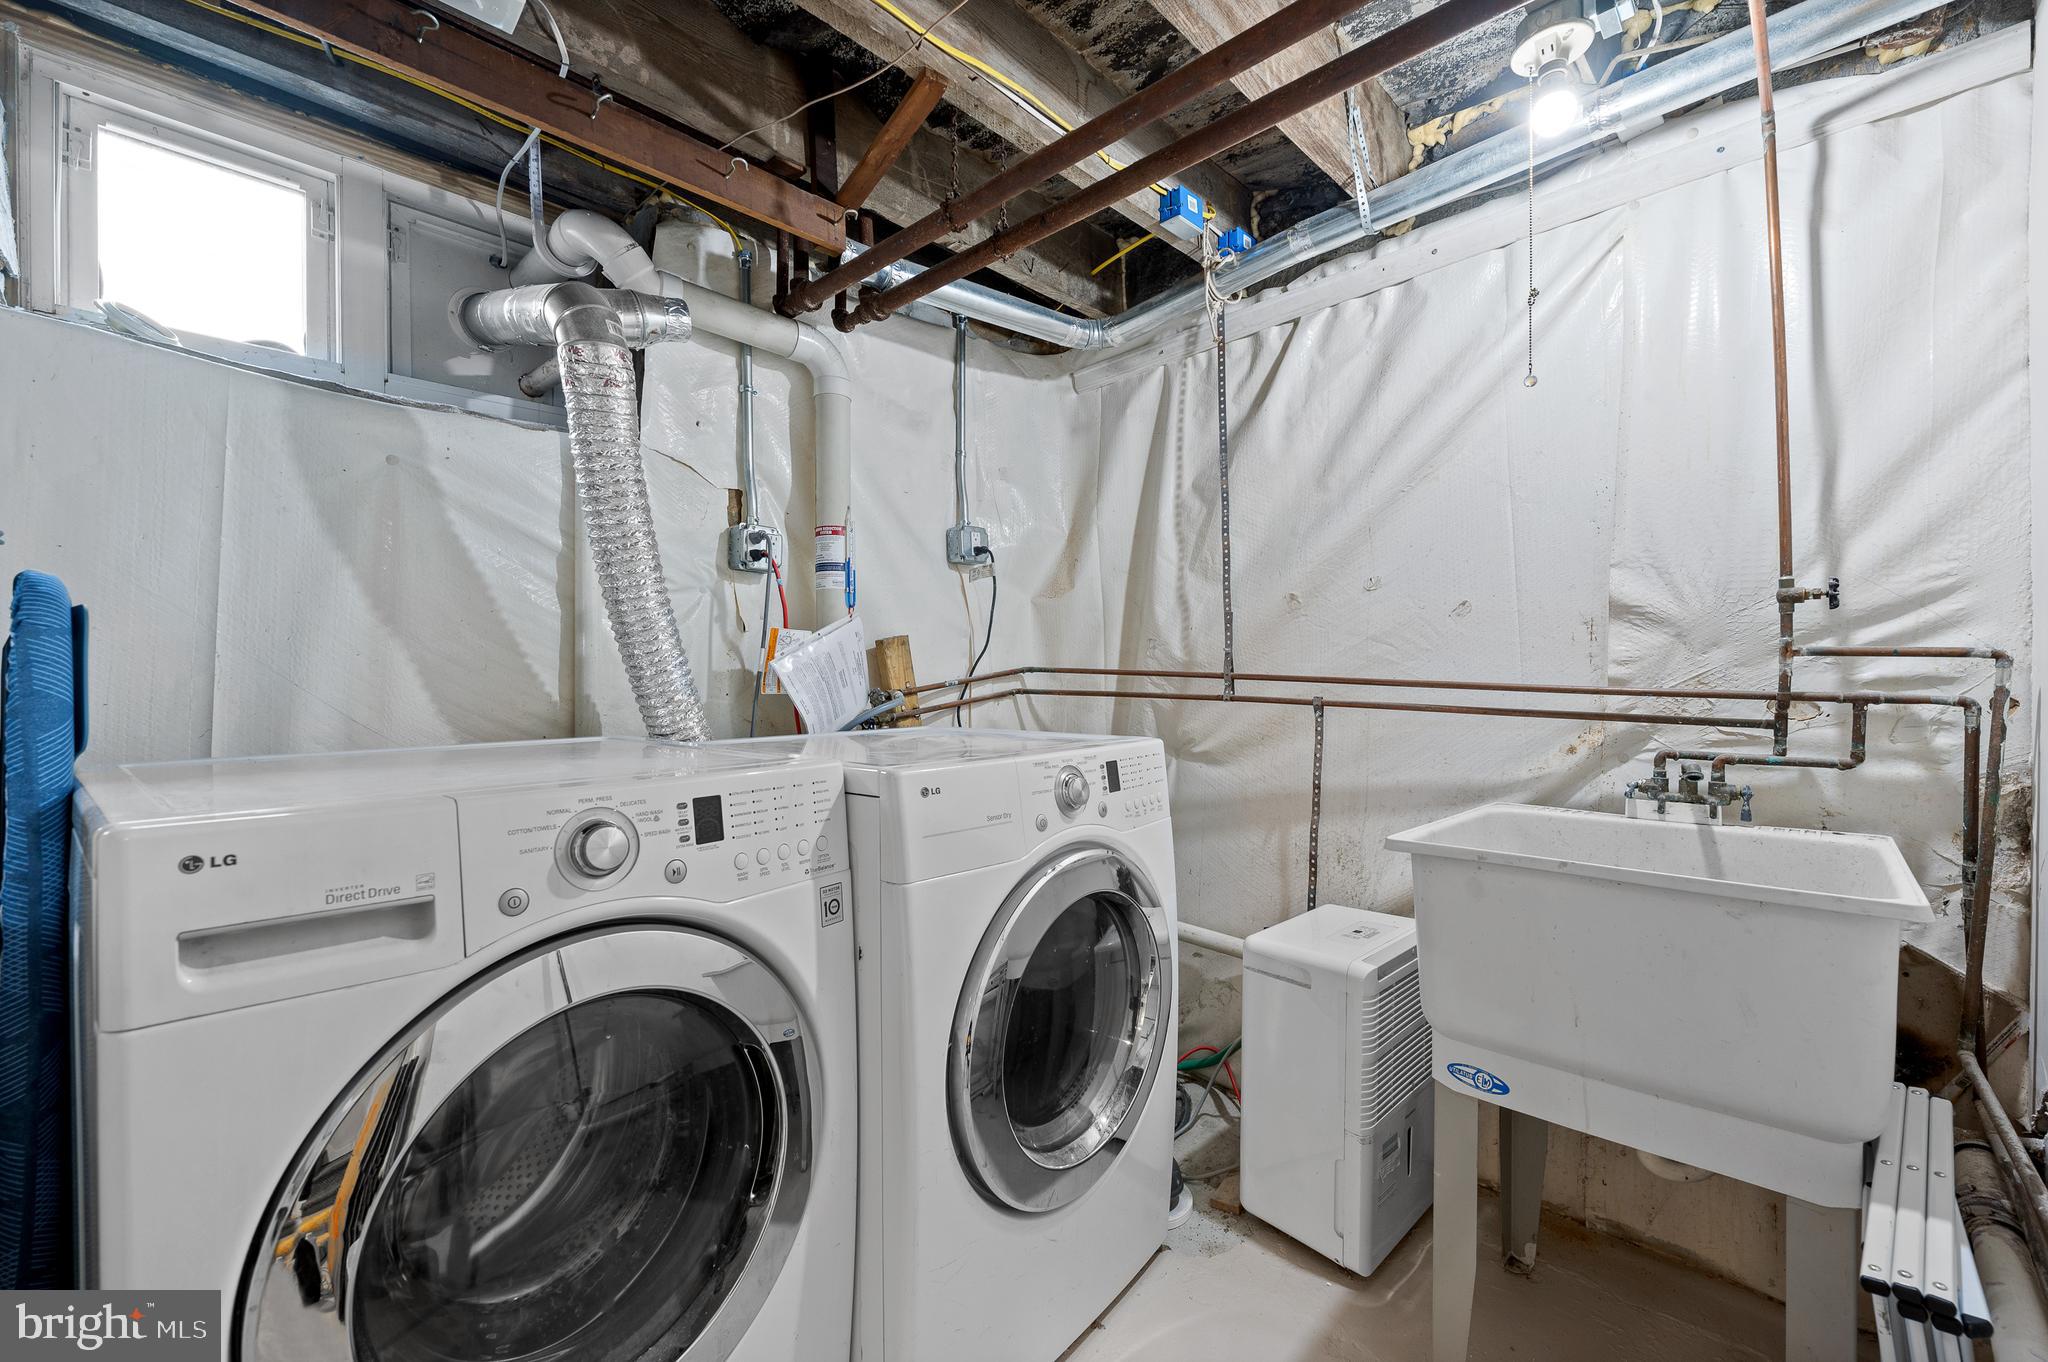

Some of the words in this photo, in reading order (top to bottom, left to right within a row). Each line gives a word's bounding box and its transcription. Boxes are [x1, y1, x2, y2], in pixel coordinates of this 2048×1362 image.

[931, 787, 941, 795] LG
[619, 799, 647, 807] DELICATES
[546, 808, 572, 816] NORMAL
[986, 813, 1003, 822] Sensor
[507, 824, 557, 836] COTTON/TOWELS
[519, 846, 549, 855] SANITARY
[210, 854, 237, 868] LG
[325, 884, 364, 893] INVERTER
[325, 890, 366, 905] Direct
[368, 886, 401, 899] Drive
[824, 898, 841, 918] 10
